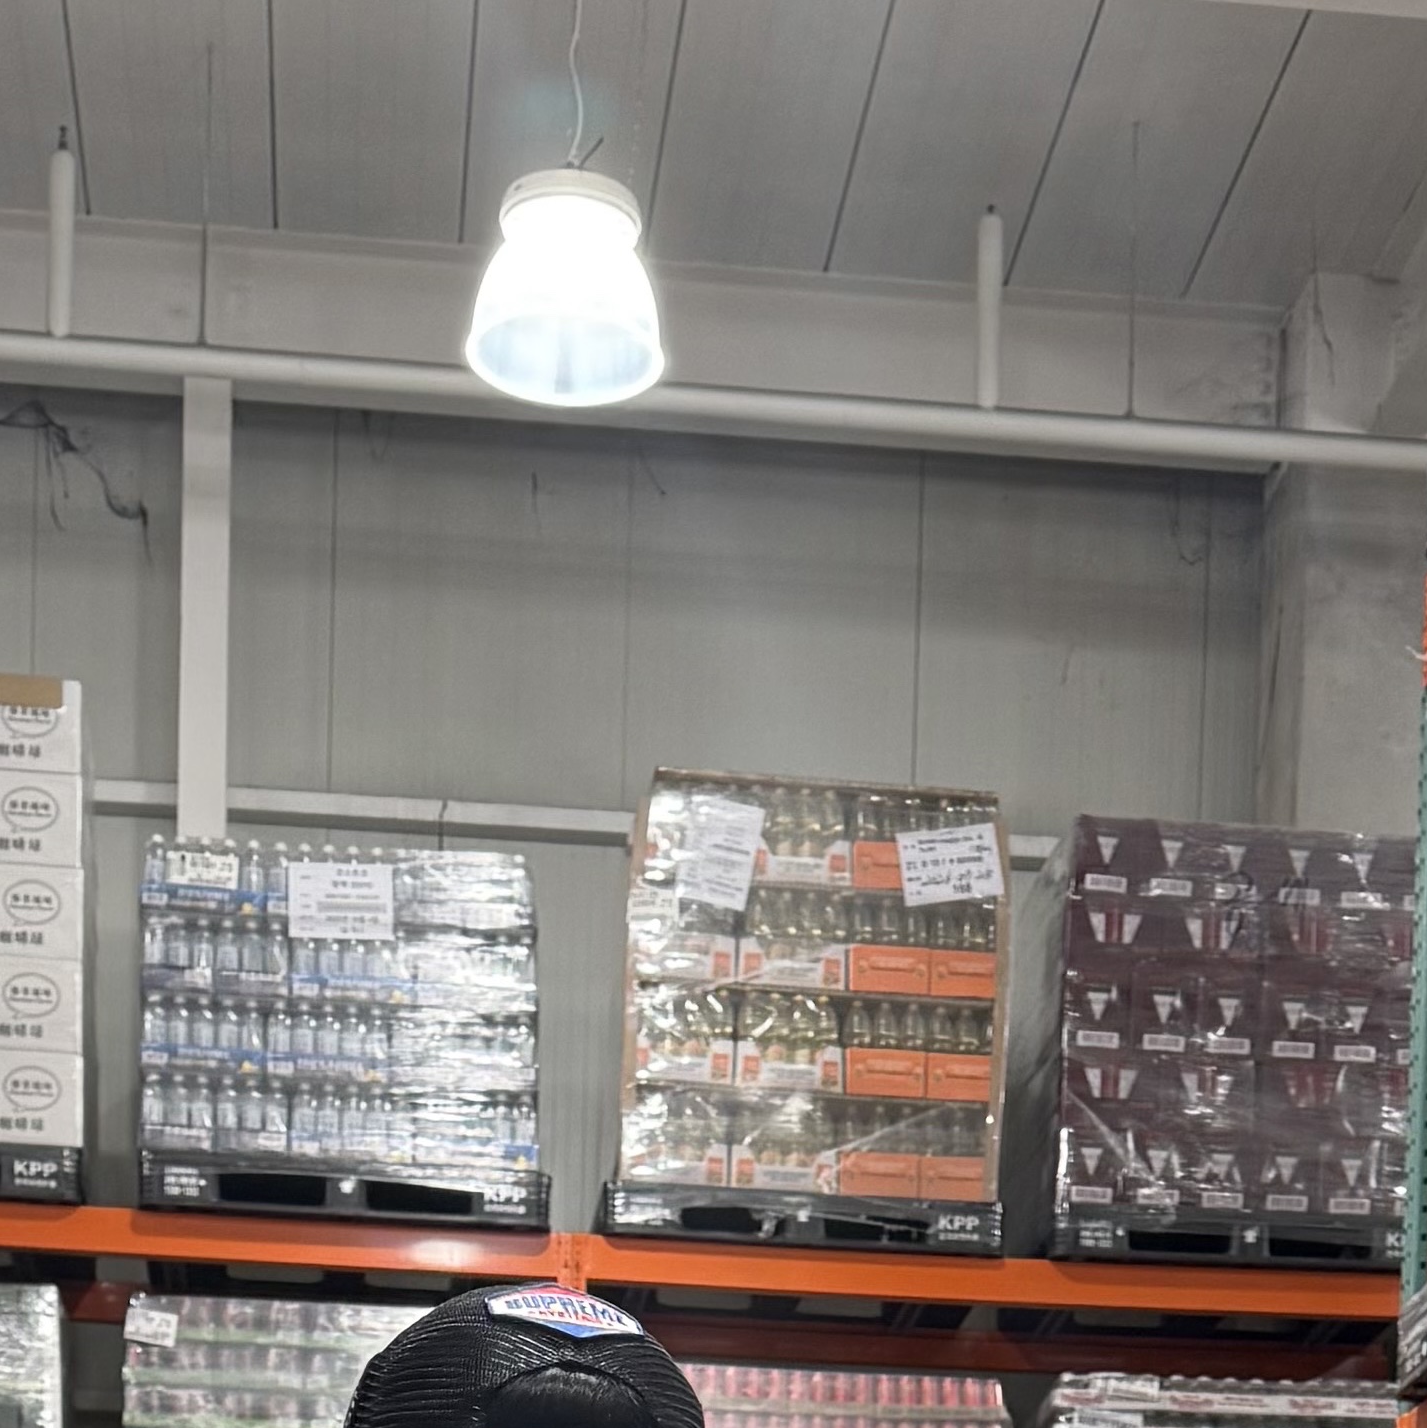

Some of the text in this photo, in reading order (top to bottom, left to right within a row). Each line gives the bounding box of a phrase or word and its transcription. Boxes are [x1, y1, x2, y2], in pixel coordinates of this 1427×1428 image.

[13, 1159, 58, 1178] KPP
[938, 1214, 980, 1231] KPP
[505, 1294, 630, 1328] SUPREME
